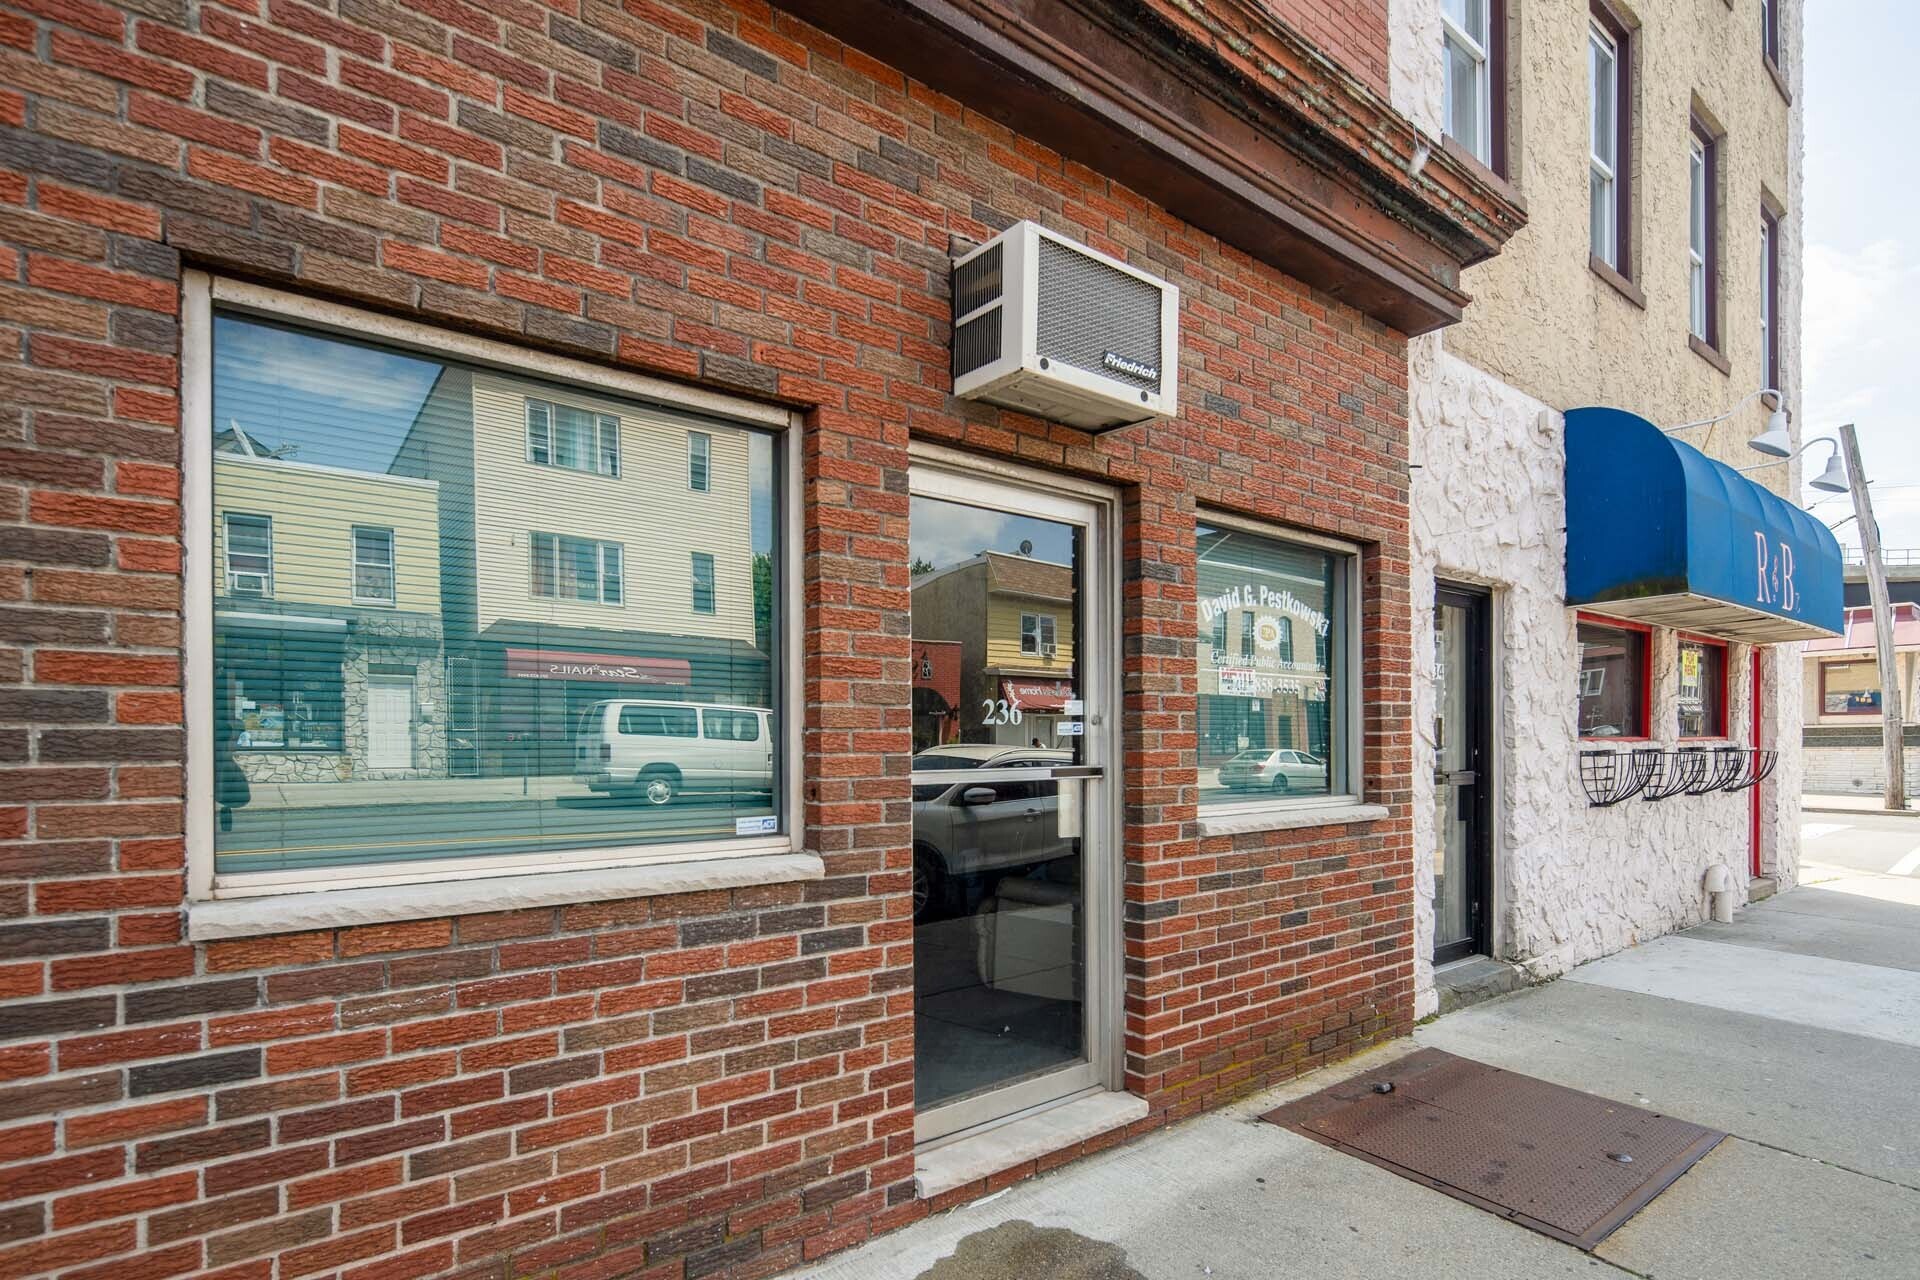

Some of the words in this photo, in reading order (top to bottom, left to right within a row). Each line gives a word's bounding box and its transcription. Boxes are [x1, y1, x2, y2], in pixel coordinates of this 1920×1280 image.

[1104, 353, 1157, 379] Friedrich
[1200, 586, 1241, 623] David
[1243, 584, 1257, 607] G.
[1260, 584, 1330, 637] Pestkowski
[1210, 650, 1247, 668] Certified
[982, 698, 1023, 725] 236
